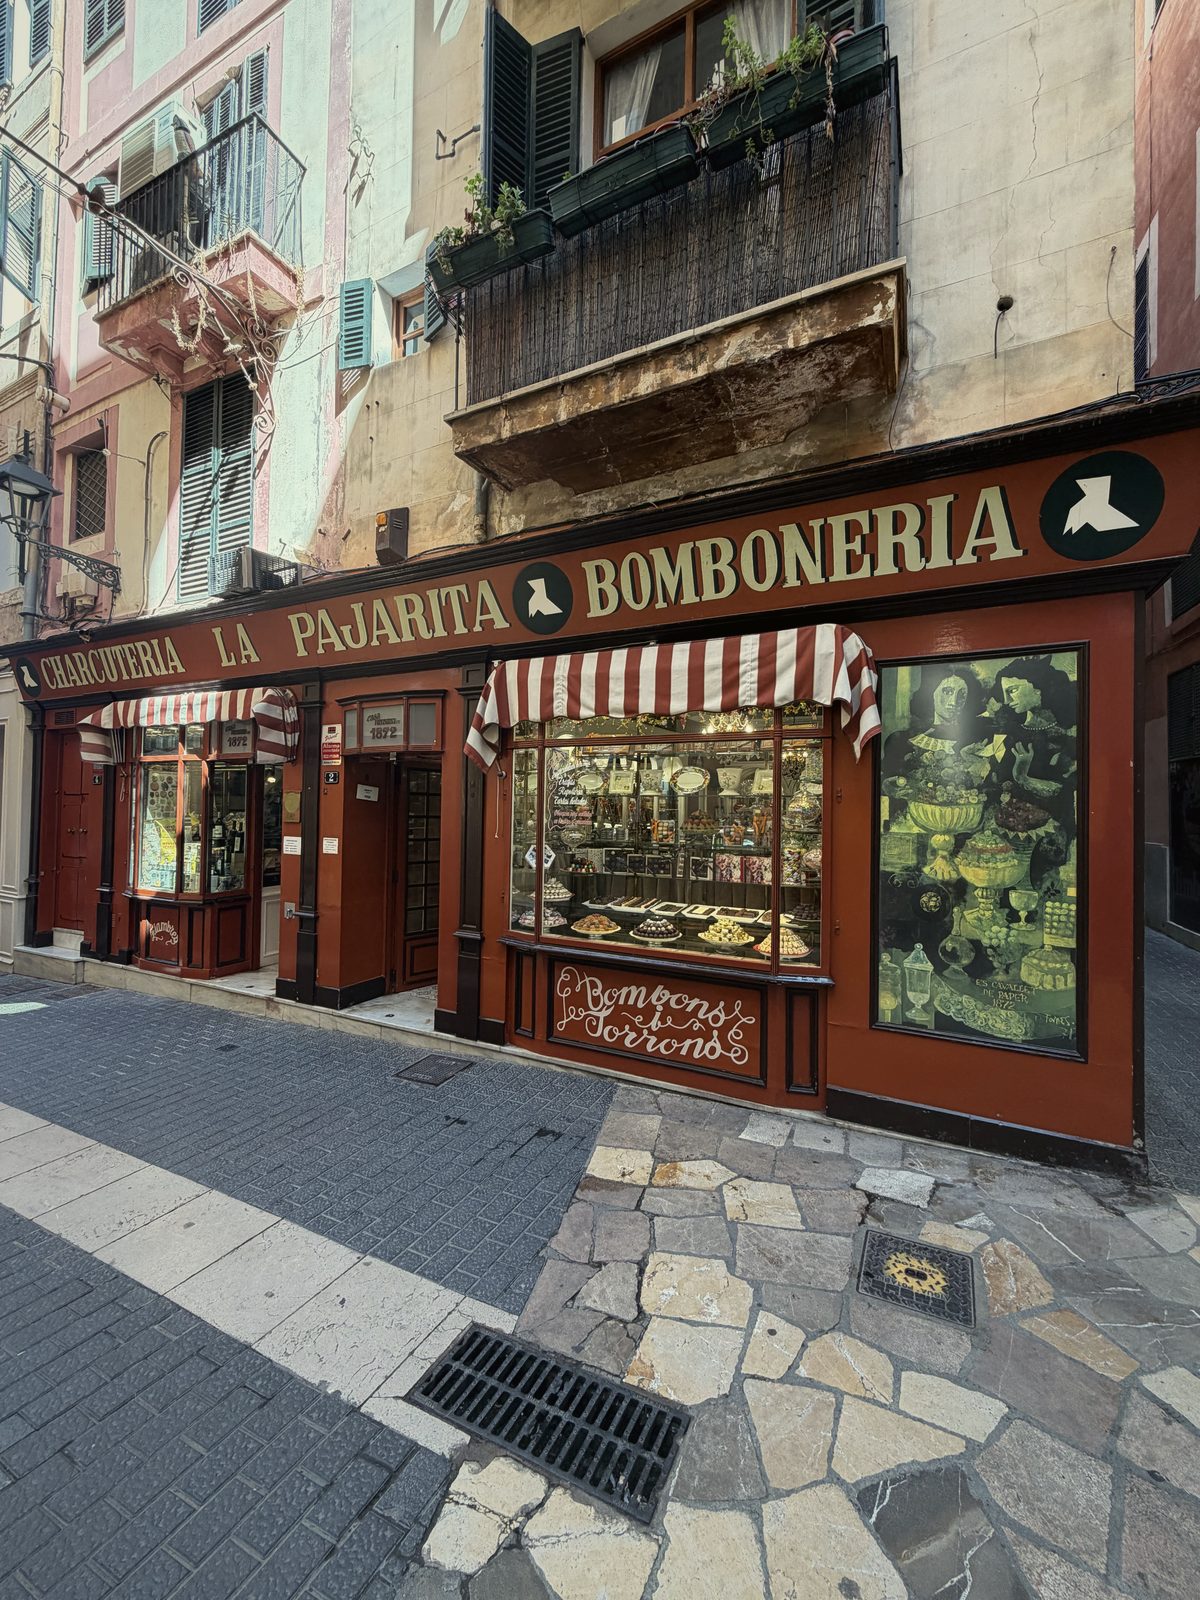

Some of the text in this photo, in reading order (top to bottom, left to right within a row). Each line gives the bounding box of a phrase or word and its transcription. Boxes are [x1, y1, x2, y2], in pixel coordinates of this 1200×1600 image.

[581, 485, 1025, 619] BOMBONERIA
[40, 579, 510, 690] CHARCUTERIA LA PAJARITA
[227, 736, 248, 748] 1872
[369, 726, 398, 740] 1872
[975, 978, 1036, 996] ES CAVALLET
[983, 988, 1028, 1004] DE PAPER
[577, 971, 726, 1028] Bombons
[992, 998, 1016, 1010] 1872
[583, 1005, 726, 1060] Torrons
